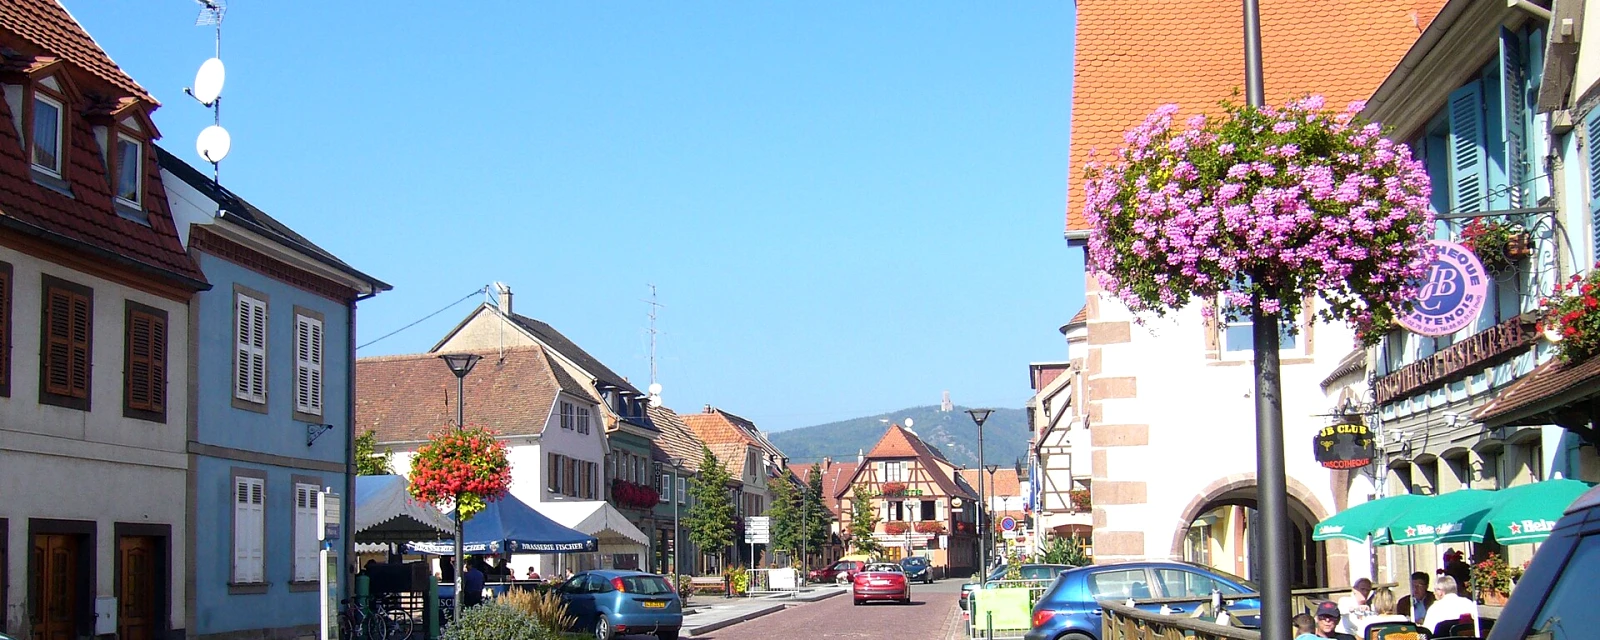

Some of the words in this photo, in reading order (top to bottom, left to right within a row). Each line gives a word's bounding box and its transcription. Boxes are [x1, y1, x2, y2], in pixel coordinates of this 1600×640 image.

[1411, 293, 1474, 325] ATENOIS
[1376, 353, 1440, 405] DISCOTHEQUE
[1443, 315, 1522, 376] RESTAURANT
[1320, 426, 1334, 437] JB
[1337, 424, 1367, 434] CLUB
[1323, 458, 1370, 469] DISCOTHEQUE
